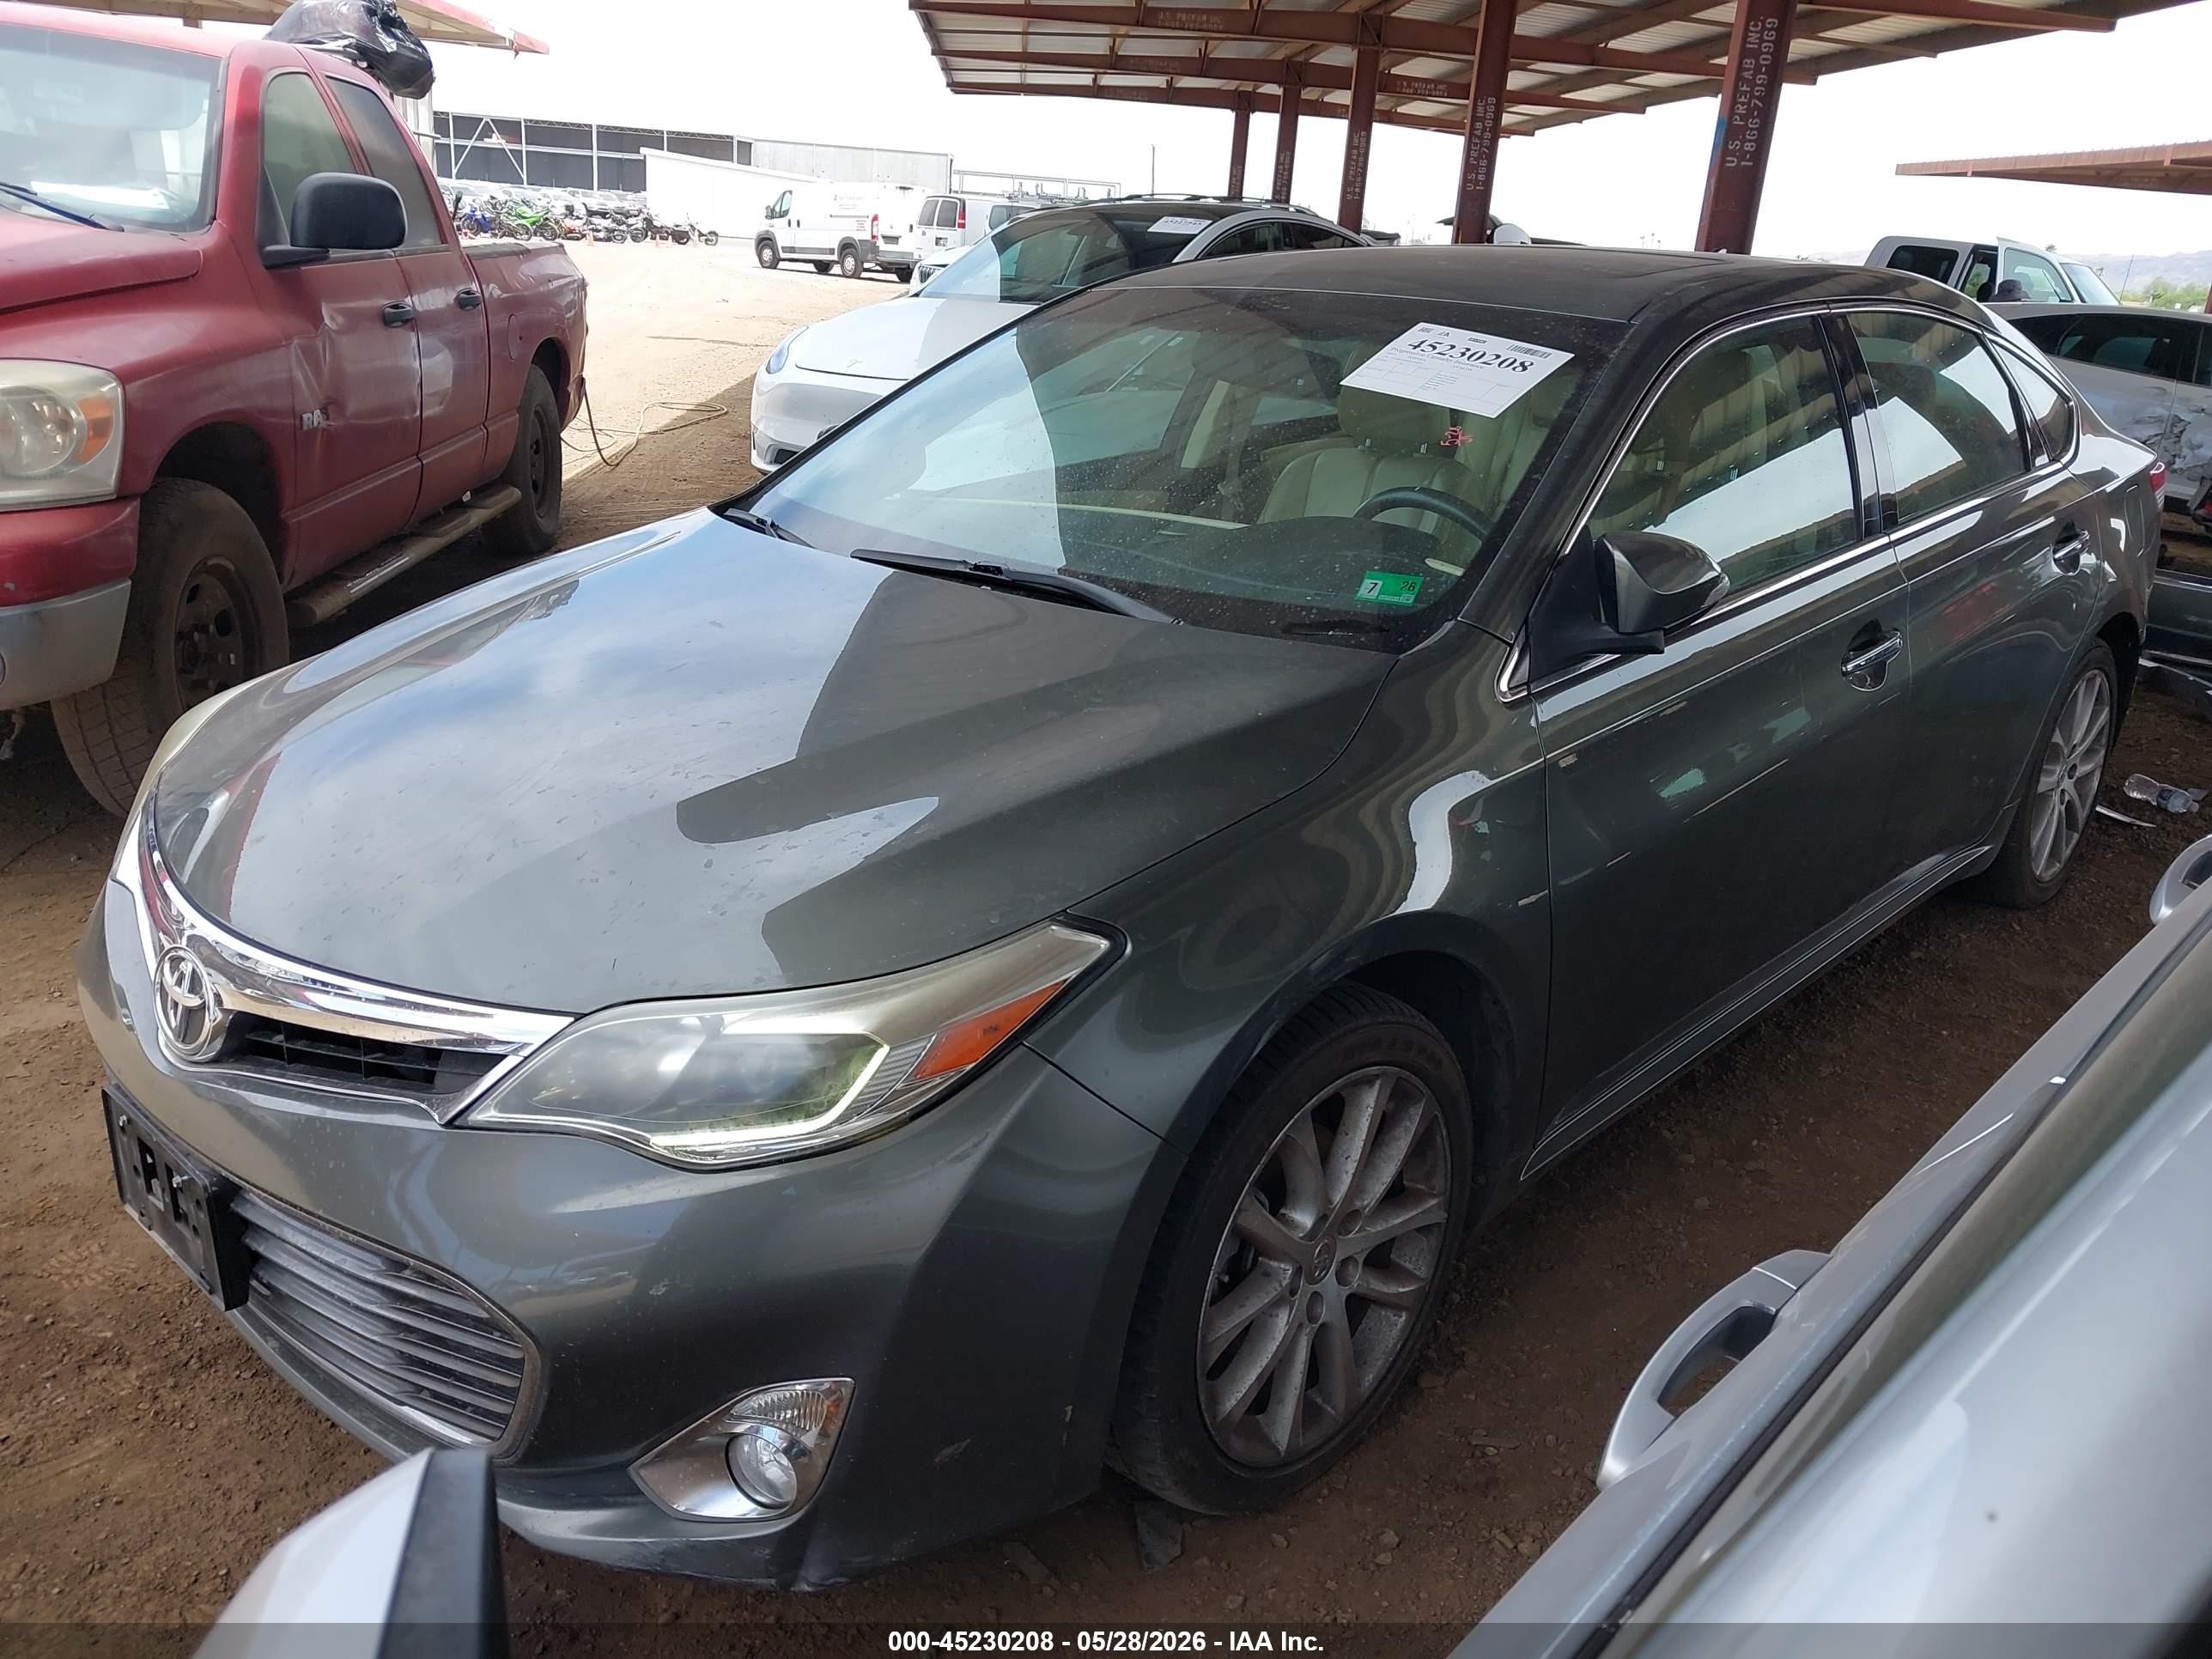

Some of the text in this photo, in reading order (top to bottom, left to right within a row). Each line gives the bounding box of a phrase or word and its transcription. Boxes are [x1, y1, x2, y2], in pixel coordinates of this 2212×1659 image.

[1725, 15, 1765, 167] U.S. PREFAB INC.
[1741, 17, 1779, 166] 1-866-799-0969
[1469, 121, 1484, 164] PREFAB
[1407, 338, 1535, 374] 45230208
[1367, 582, 1379, 594] 7
